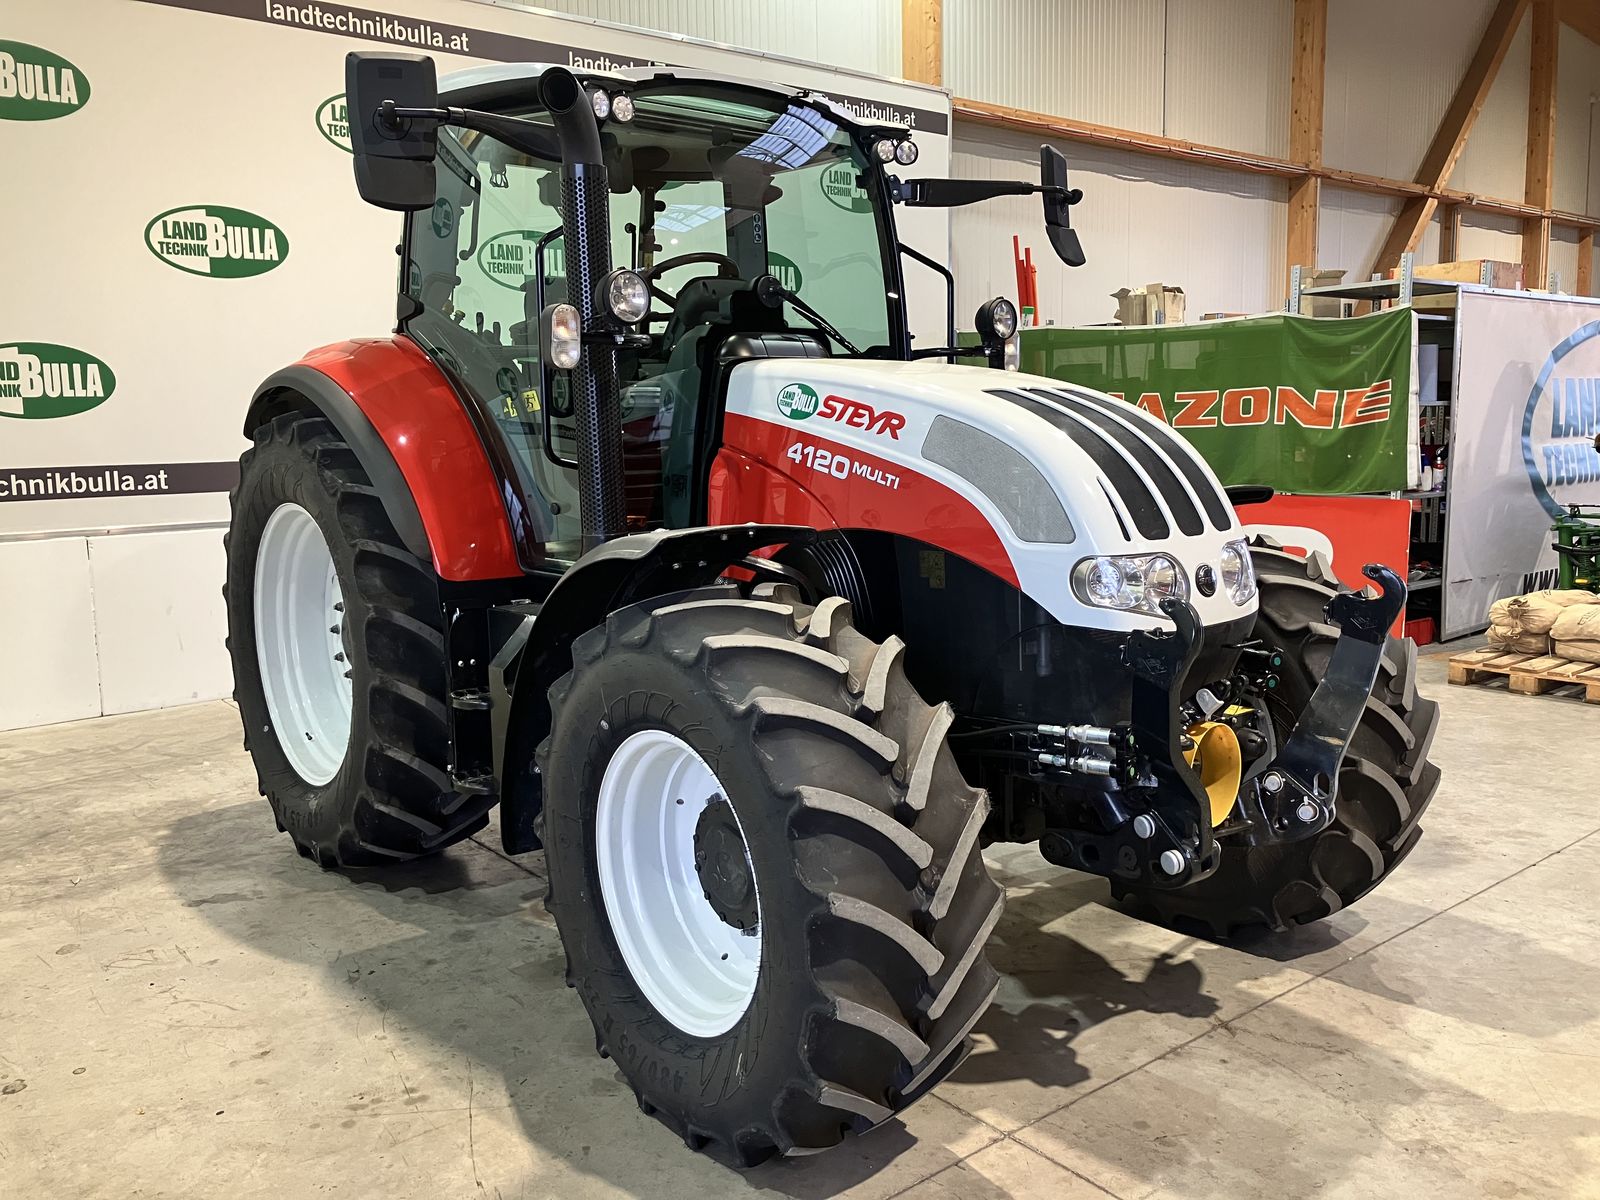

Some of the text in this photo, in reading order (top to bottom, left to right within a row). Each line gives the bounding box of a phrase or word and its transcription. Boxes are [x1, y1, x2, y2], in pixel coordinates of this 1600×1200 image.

[265, 0, 469, 52] landtechnikbulla.at
[828, 169, 852, 186] LAND
[162, 220, 207, 241] LAND
[207, 216, 279, 261] BULLA
[158, 240, 209, 257] TECHNIK
[490, 243, 524, 261] LAND
[487, 261, 525, 275] TECHNIK
[18, 353, 104, 397] BULLA
[791, 388, 817, 414] BULLA
[816, 394, 907, 441] STEYR
[786, 442, 901, 491] 4120 MULTI
